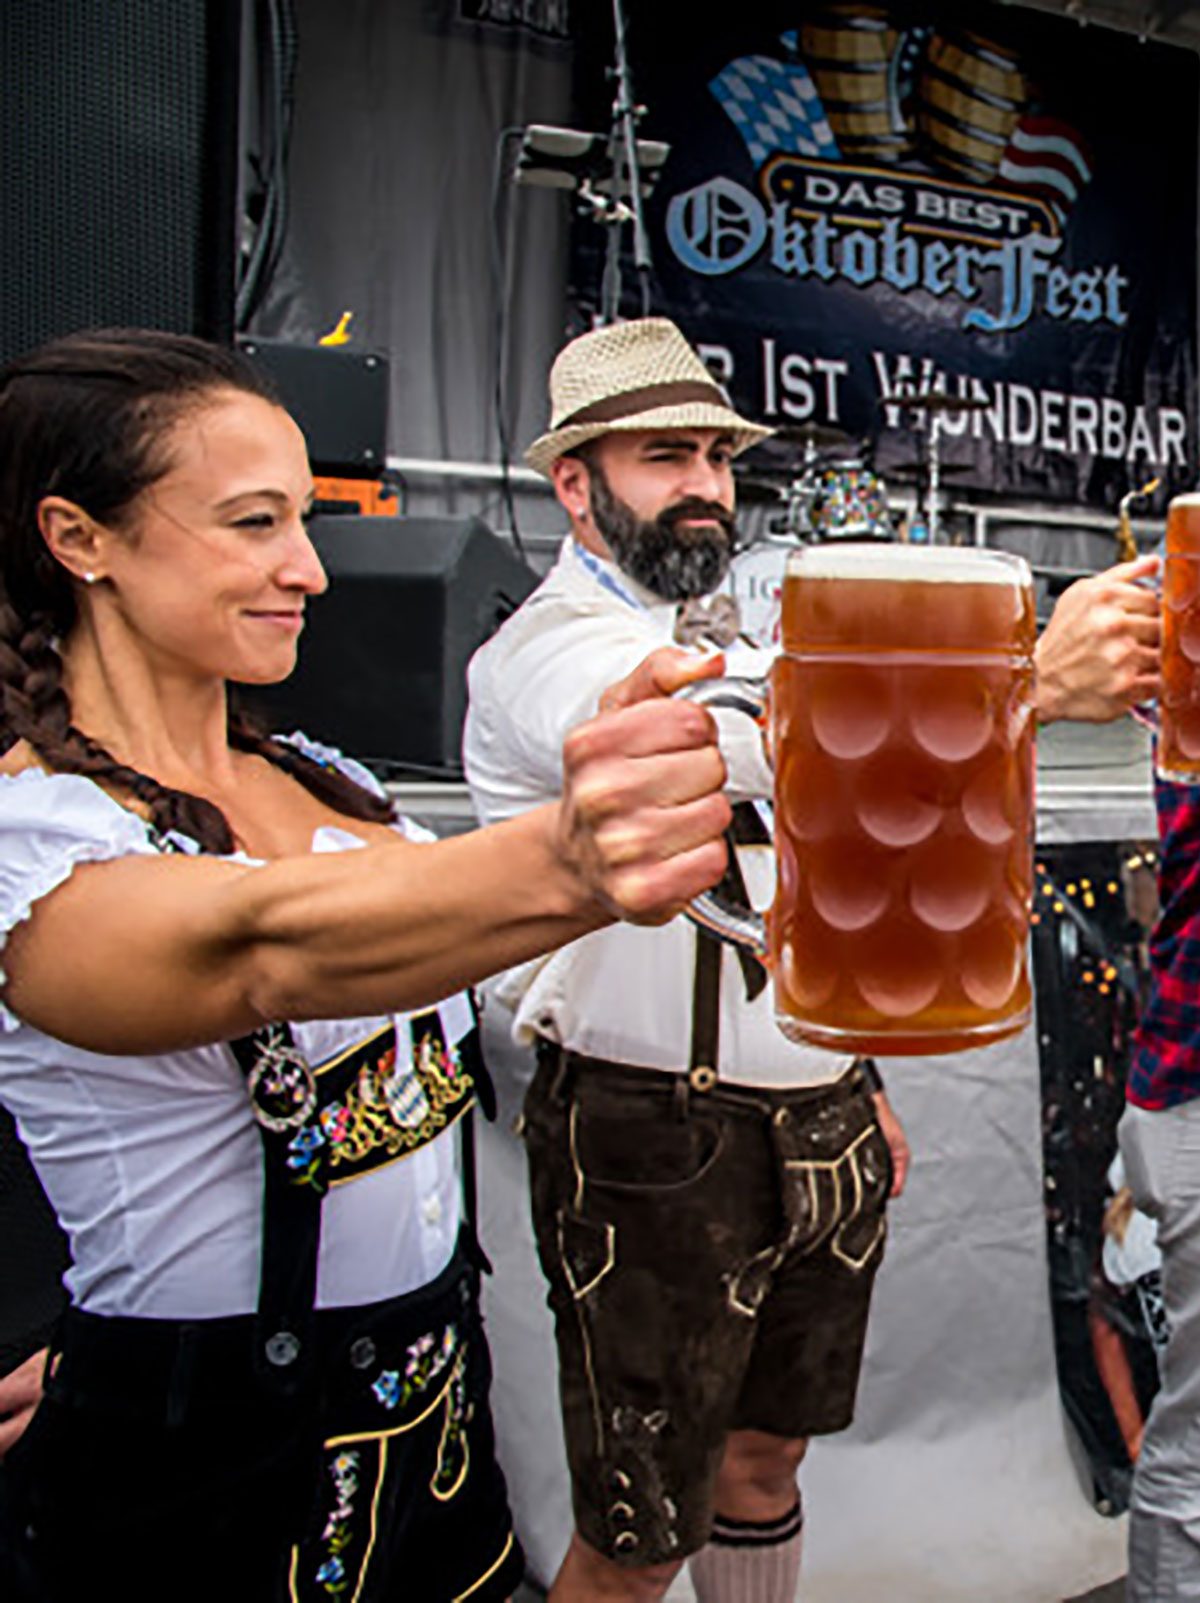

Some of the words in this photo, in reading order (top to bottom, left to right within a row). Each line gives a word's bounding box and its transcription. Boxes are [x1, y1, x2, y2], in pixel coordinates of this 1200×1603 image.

[804, 174, 904, 214] DAS
[915, 190, 1029, 234] BEST
[762, 338, 848, 422] IST
[872, 351, 1187, 466] WUNDERBAR
